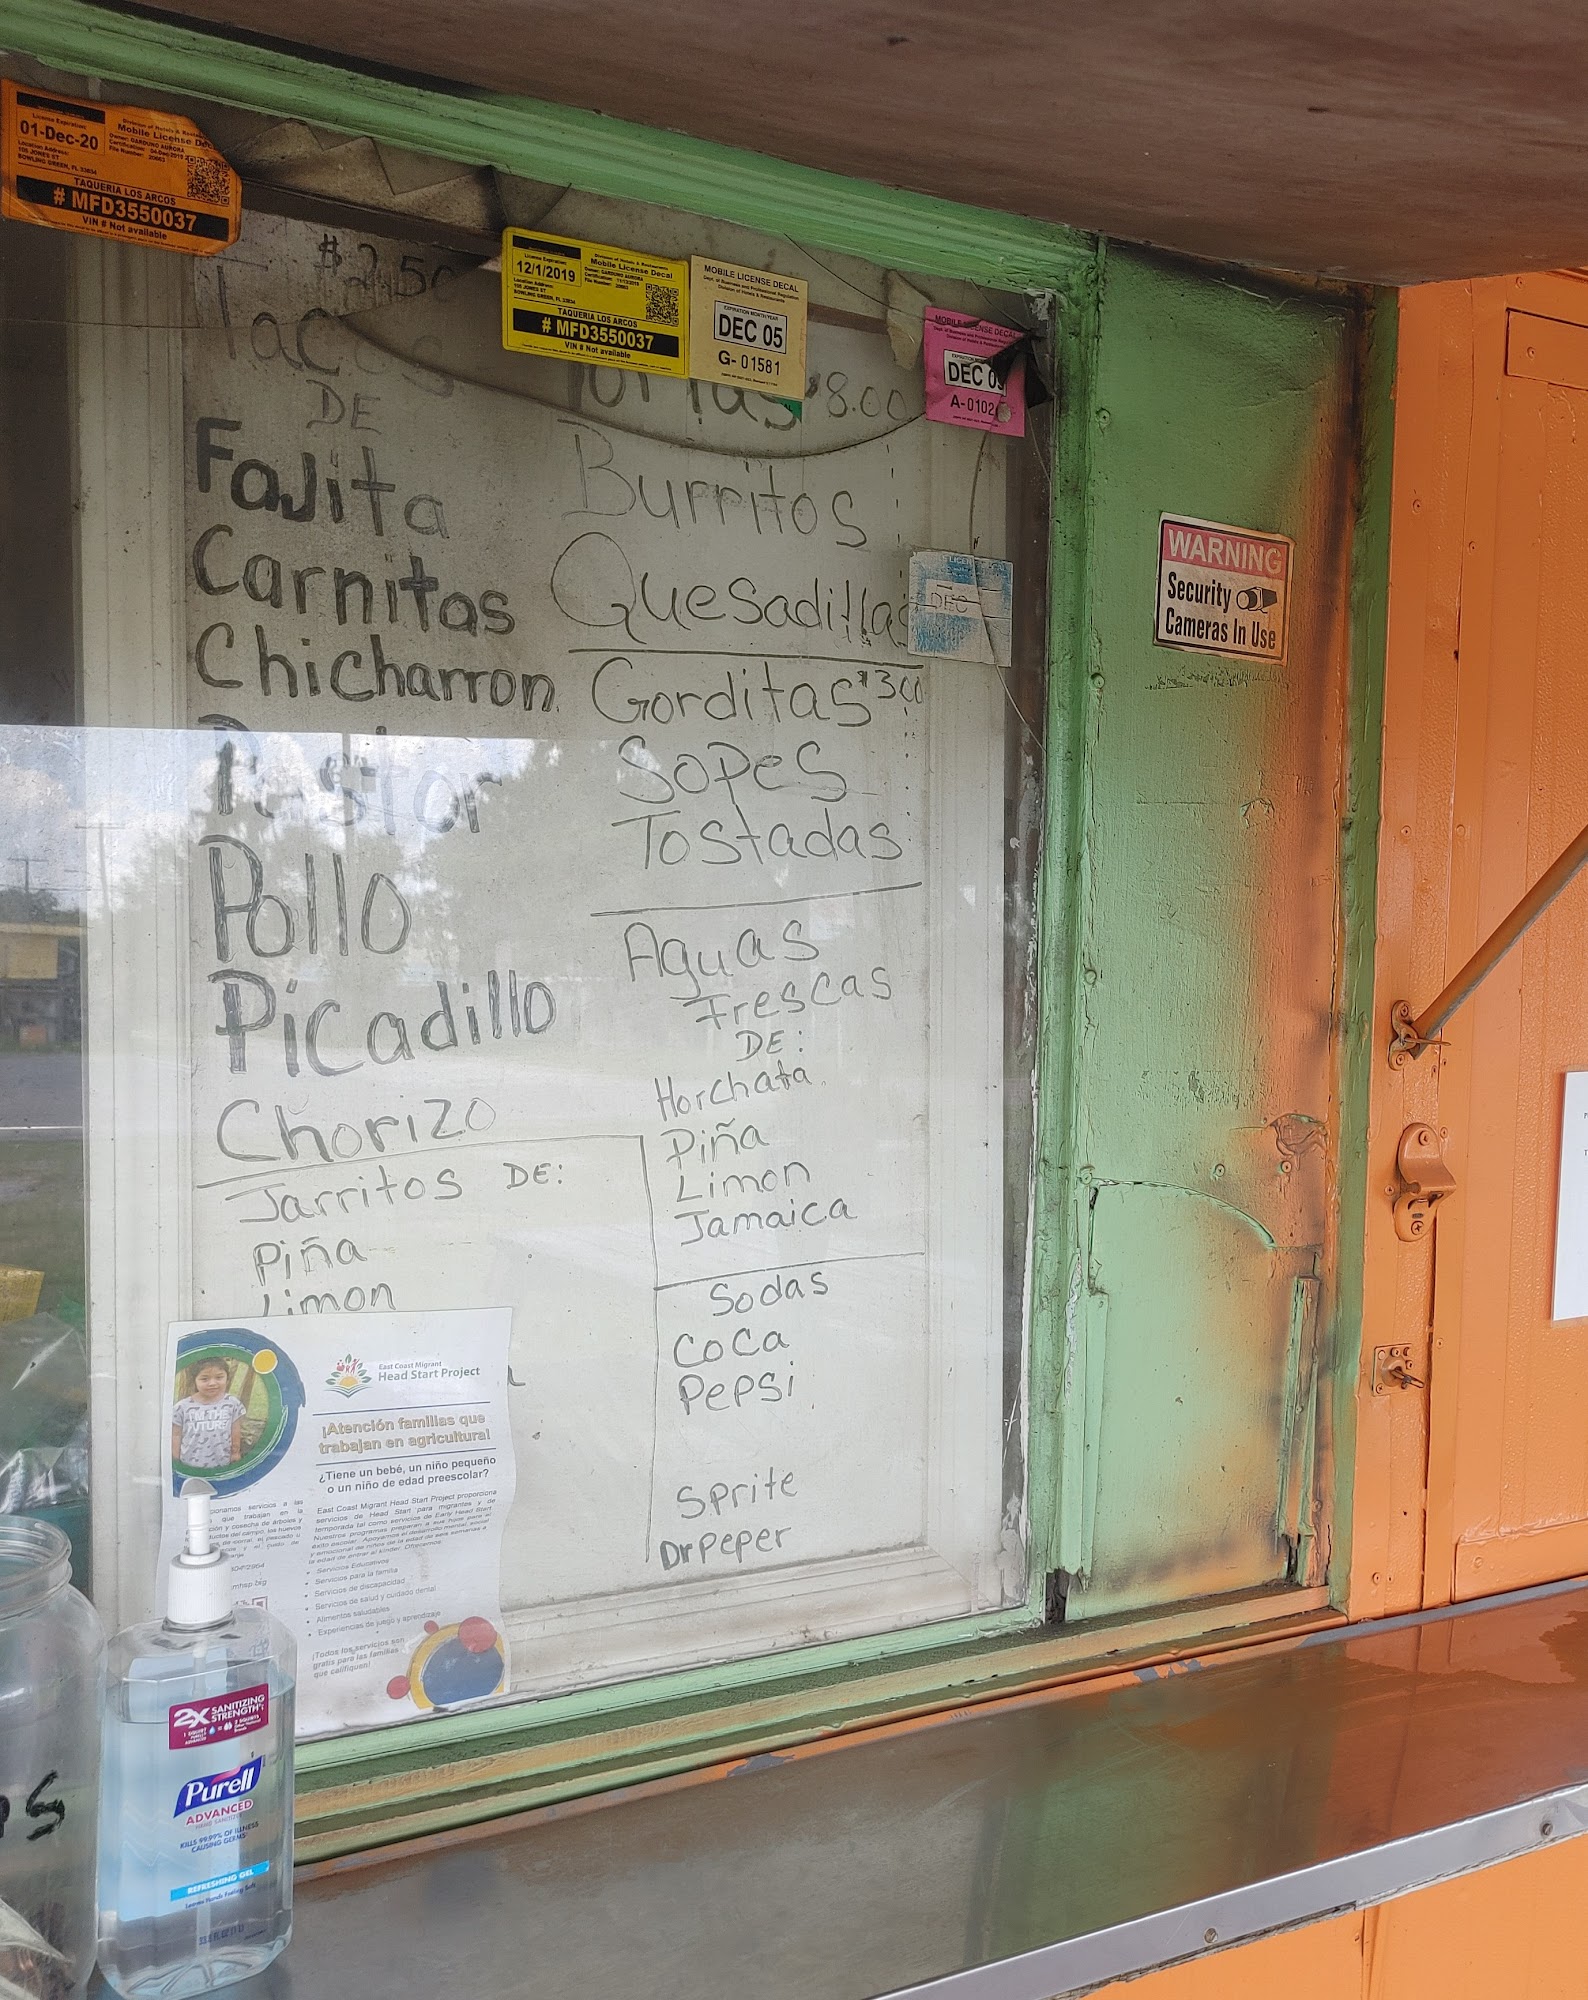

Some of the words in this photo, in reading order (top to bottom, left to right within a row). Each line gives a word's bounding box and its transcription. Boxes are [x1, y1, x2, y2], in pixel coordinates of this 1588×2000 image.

[20, 120, 98, 150] 01-Dec-20
[118, 123, 150, 138] Mobile
[153, 131, 192, 146] License
[74, 177, 122, 196] TAQUERIA
[124, 189, 143, 200] LOS
[145, 194, 176, 206] ARCOS
[72, 190, 197, 232] MFD3550037
[82, 216, 100, 226] VIN
[110, 220, 126, 232] Not
[128, 226, 168, 241] available
[516, 260, 576, 284] 12/1/2019
[591, 258, 616, 270] Mobile
[618, 263, 648, 275] License
[651, 270, 673, 280] Decal
[704, 264, 735, 278] MOBILE
[738, 272, 771, 287] LICENSE
[773, 280, 799, 292] DECAL
[542, 316, 552, 334] #
[556, 319, 654, 350] MFD3550037
[558, 308, 595, 321] TAQUERIA
[598, 315, 611, 324] LOS
[613, 318, 638, 328] ARCOS
[719, 313, 757, 343] DEC
[763, 324, 783, 349] 05
[935, 314, 962, 326] MOBILE
[994, 328, 1016, 338] DECAL
[564, 341, 578, 350] VIN
[586, 345, 599, 354] Not
[600, 348, 631, 360] available
[948, 361, 983, 386] DEC
[557, 418, 867, 548] Burritos
[1168, 528, 1282, 574] WARNING
[192, 524, 515, 637] Carnitas
[1167, 572, 1232, 614] Security
[1166, 607, 1228, 642] Cameras
[1233, 618, 1246, 645] In
[1252, 621, 1276, 650] Use
[195, 622, 555, 712] Chicharron
[592, 661, 872, 727] Gorditas
[611, 804, 903, 870] Tostadas
[198, 834, 412, 962] Pollo
[624, 920, 820, 1001] Aguas
[682, 966, 892, 1030] Frescas
[207, 968, 557, 1078] Picadillo
[654, 1060, 813, 1121] Horchata
[225, 1164, 463, 1224] Jarritos
[502, 1161, 564, 1190] DE:
[676, 1161, 811, 1203] Limon
[674, 1198, 858, 1247] Jamaica
[709, 1272, 829, 1317] Sodas
[415, 1360, 442, 1370] Migrant
[673, 1327, 790, 1368] Coca
[378, 1371, 408, 1382] Head
[410, 1369, 438, 1380] Start
[441, 1366, 481, 1380] Project
[398, 1415, 456, 1430] familias
[459, 1412, 486, 1426] que
[318, 1438, 382, 1455] trabajan
[386, 1438, 404, 1448] en
[319, 1470, 356, 1484] ¿Tiene
[360, 1469, 372, 1478] un
[376, 1464, 406, 1476] bebé,
[409, 1464, 422, 1472] un
[425, 1460, 448, 1470] niño
[452, 1456, 496, 1470] pequeño
[327, 1486, 334, 1494] o
[338, 1484, 352, 1492] un
[355, 1480, 379, 1490] niño
[382, 1478, 396, 1488] de
[398, 1476, 424, 1486] edad
[428, 1468, 489, 1485] preescolar?
[676, 1466, 798, 1519] Sprite
[174, 1707, 210, 1729] 2X
[212, 1694, 264, 1714] SANITIZING
[186, 1766, 255, 1808] Purell
[186, 1800, 252, 1826] ADVANCED
[234, 1820, 259, 1834] ILLNESS
[192, 1840, 222, 1854] CAUSING
[188, 1874, 237, 1895] REFRESHING
[240, 1868, 254, 1879] GEL
